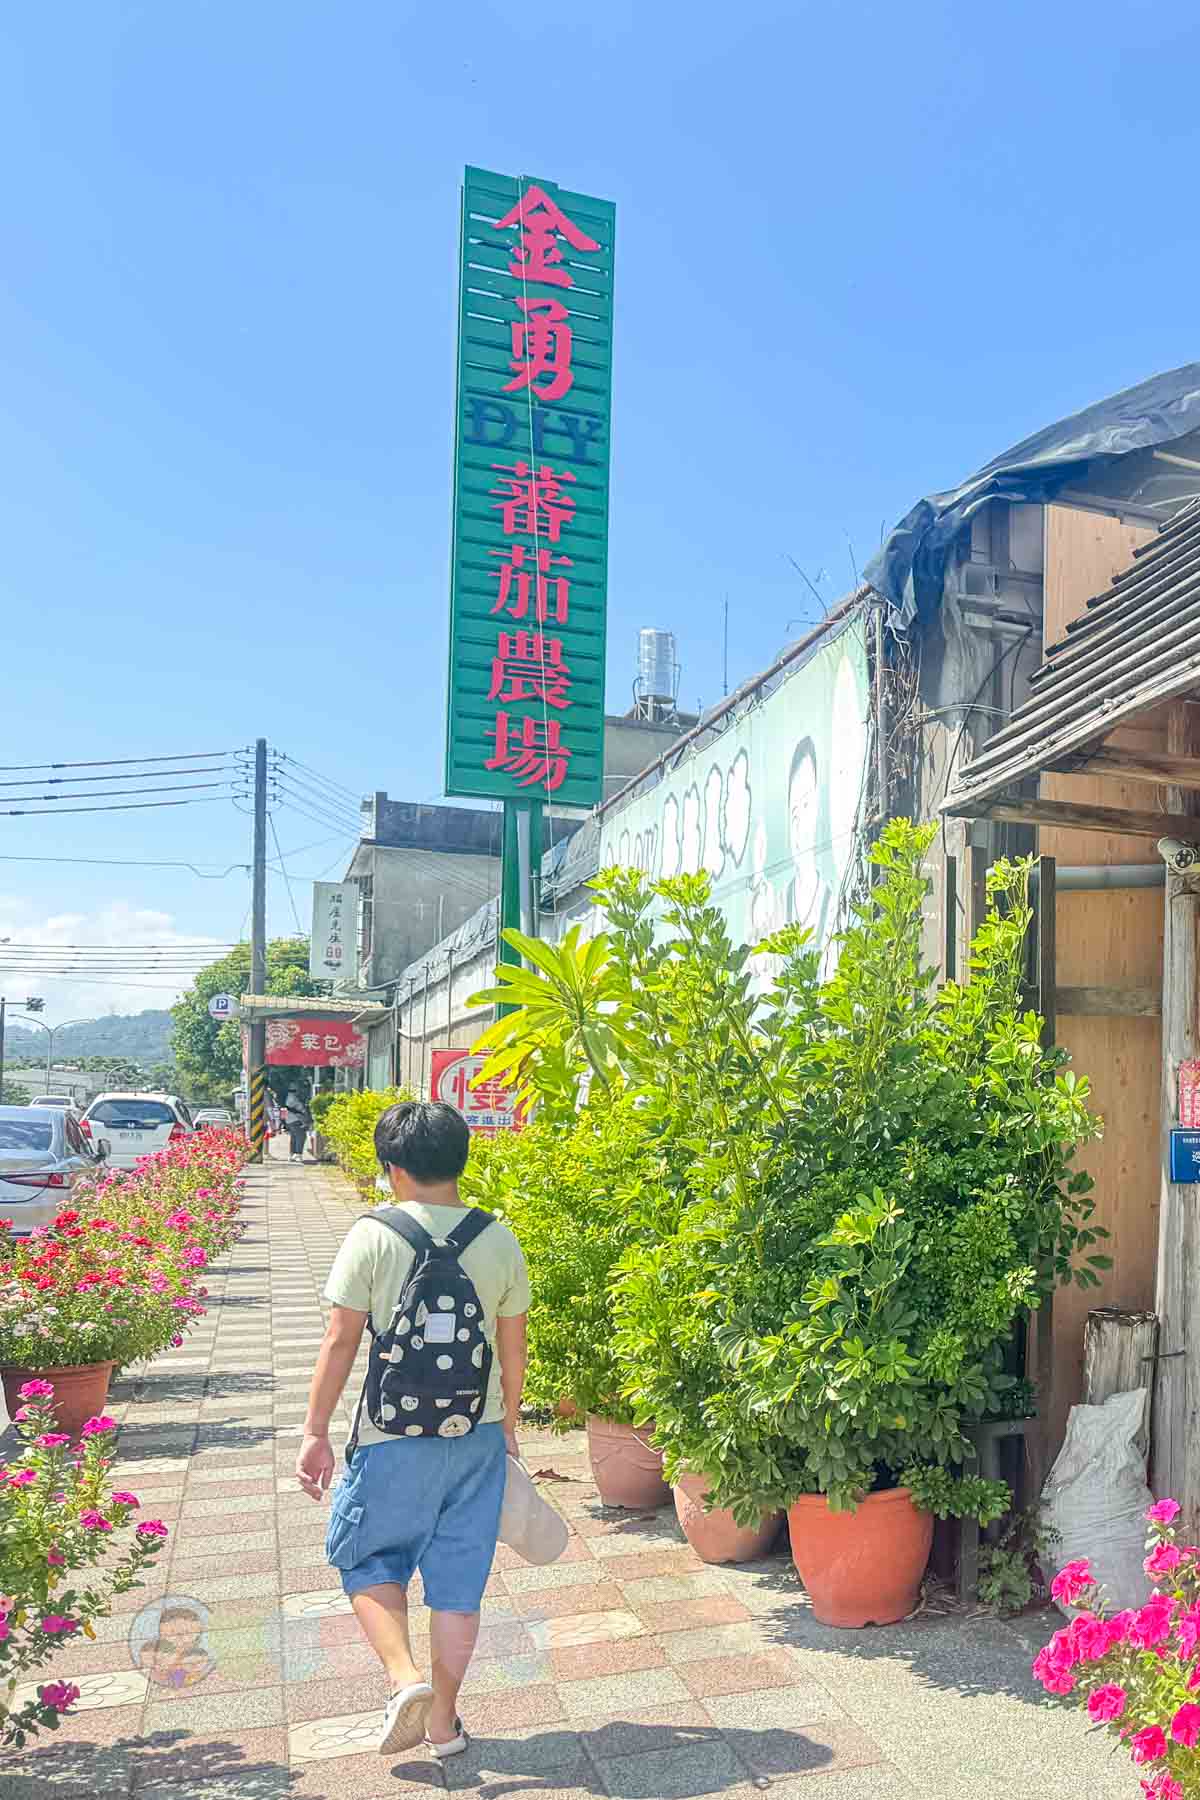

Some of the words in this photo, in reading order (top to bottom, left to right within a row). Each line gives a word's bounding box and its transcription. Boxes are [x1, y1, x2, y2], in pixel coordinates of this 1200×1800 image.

[492, 185, 602, 401] 金勇
[465, 398, 604, 464] DIY
[483, 461, 577, 793] 蕃茄農場
[301, 1033, 342, 1050] 菜包
